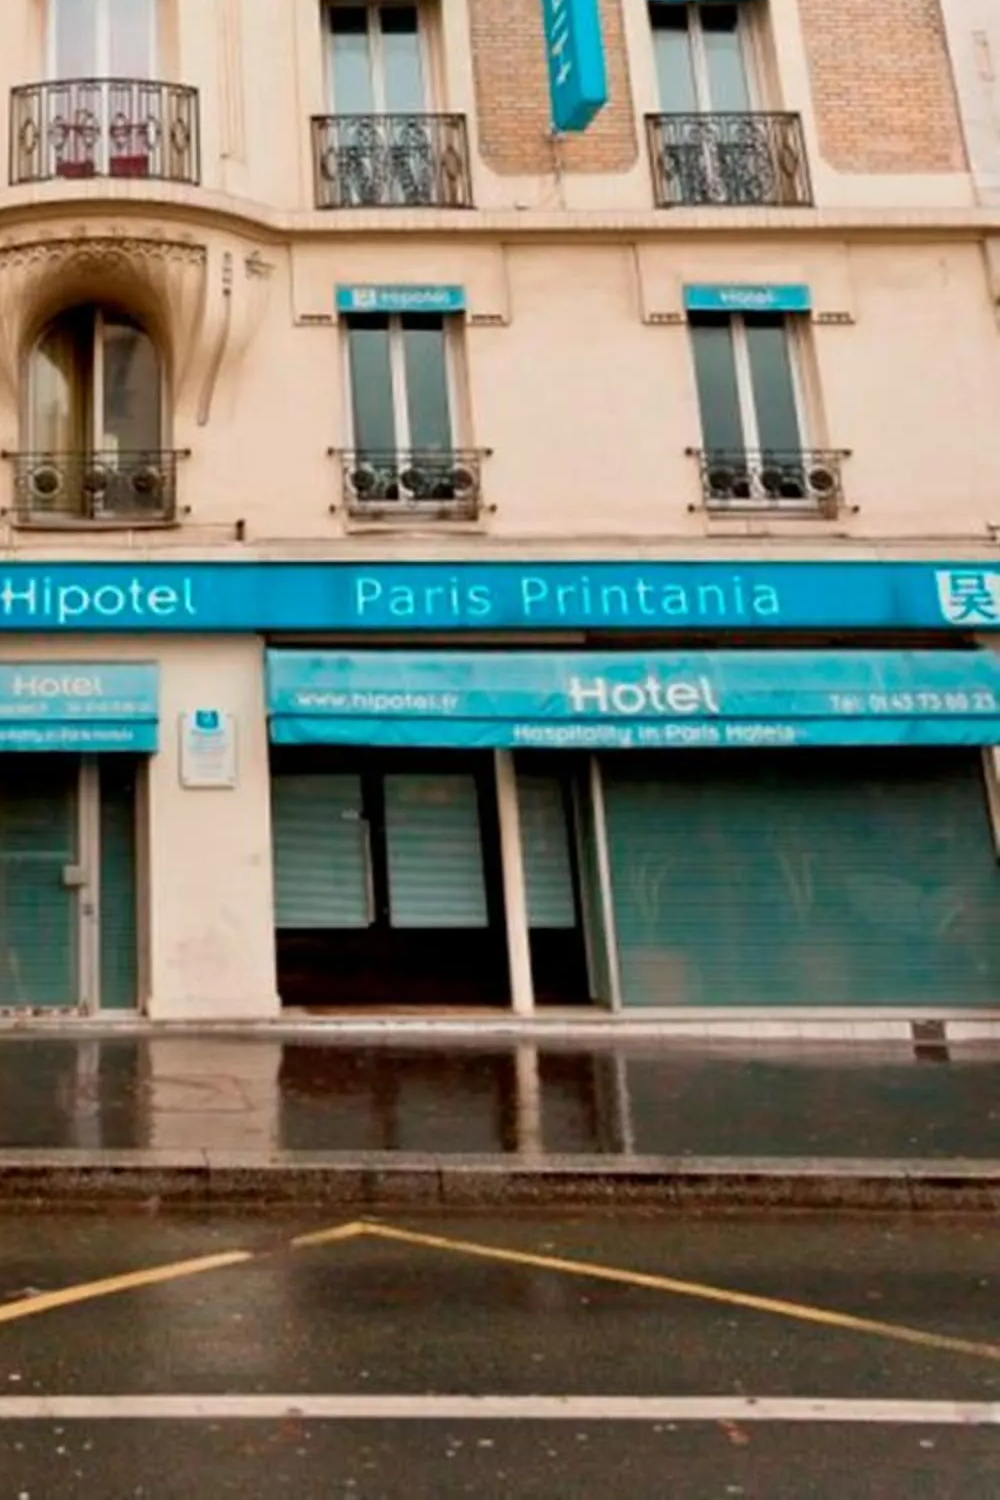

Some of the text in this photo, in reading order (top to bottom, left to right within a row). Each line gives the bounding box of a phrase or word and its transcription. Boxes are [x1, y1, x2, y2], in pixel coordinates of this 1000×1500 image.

[0, 576, 197, 625] Hipotel
[355, 576, 781, 617] Paris Printania
[12, 673, 103, 697] Hotel
[568, 675, 720, 713] Hotel
